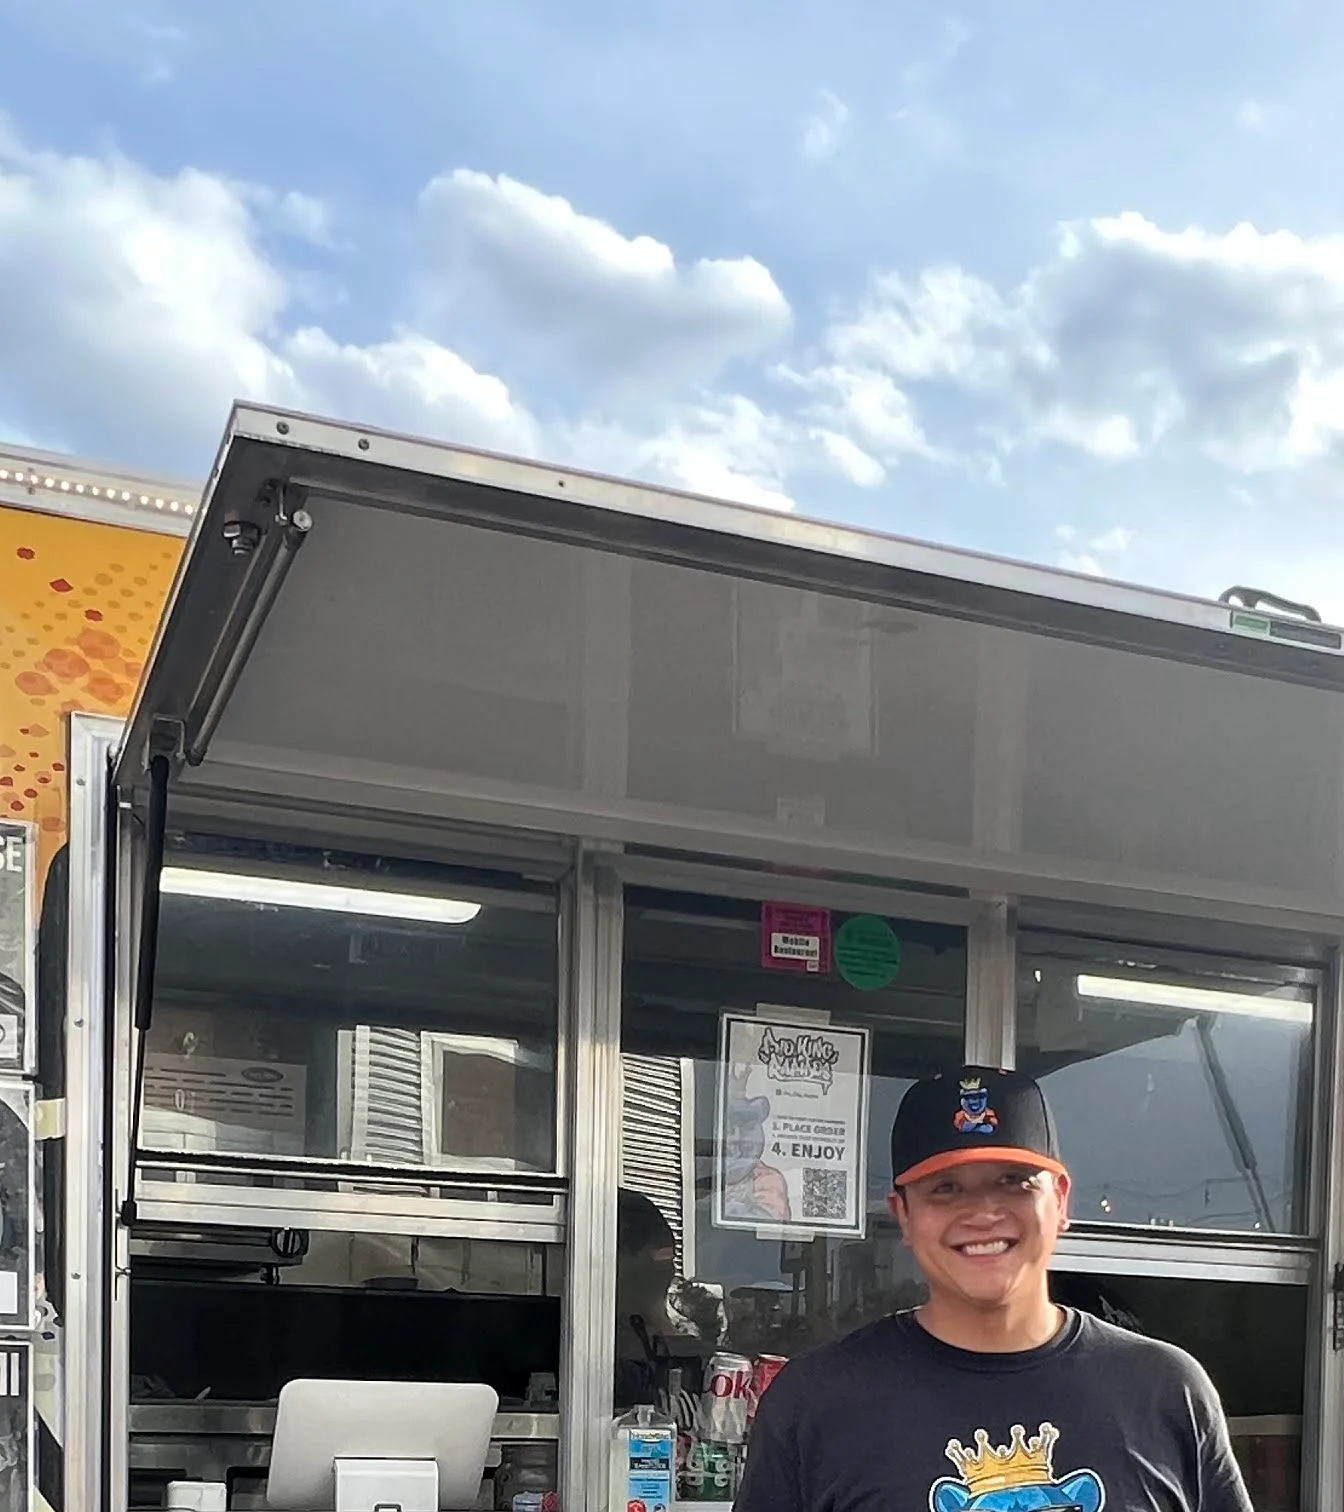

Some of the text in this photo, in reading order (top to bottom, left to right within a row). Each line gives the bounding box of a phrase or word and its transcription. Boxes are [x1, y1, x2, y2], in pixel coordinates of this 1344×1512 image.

[782, 936, 810, 947] Mobile
[783, 1122, 812, 1135] PLACE
[814, 1124, 846, 1136] ORDER
[771, 1142, 846, 1161] 4. ENJOY
